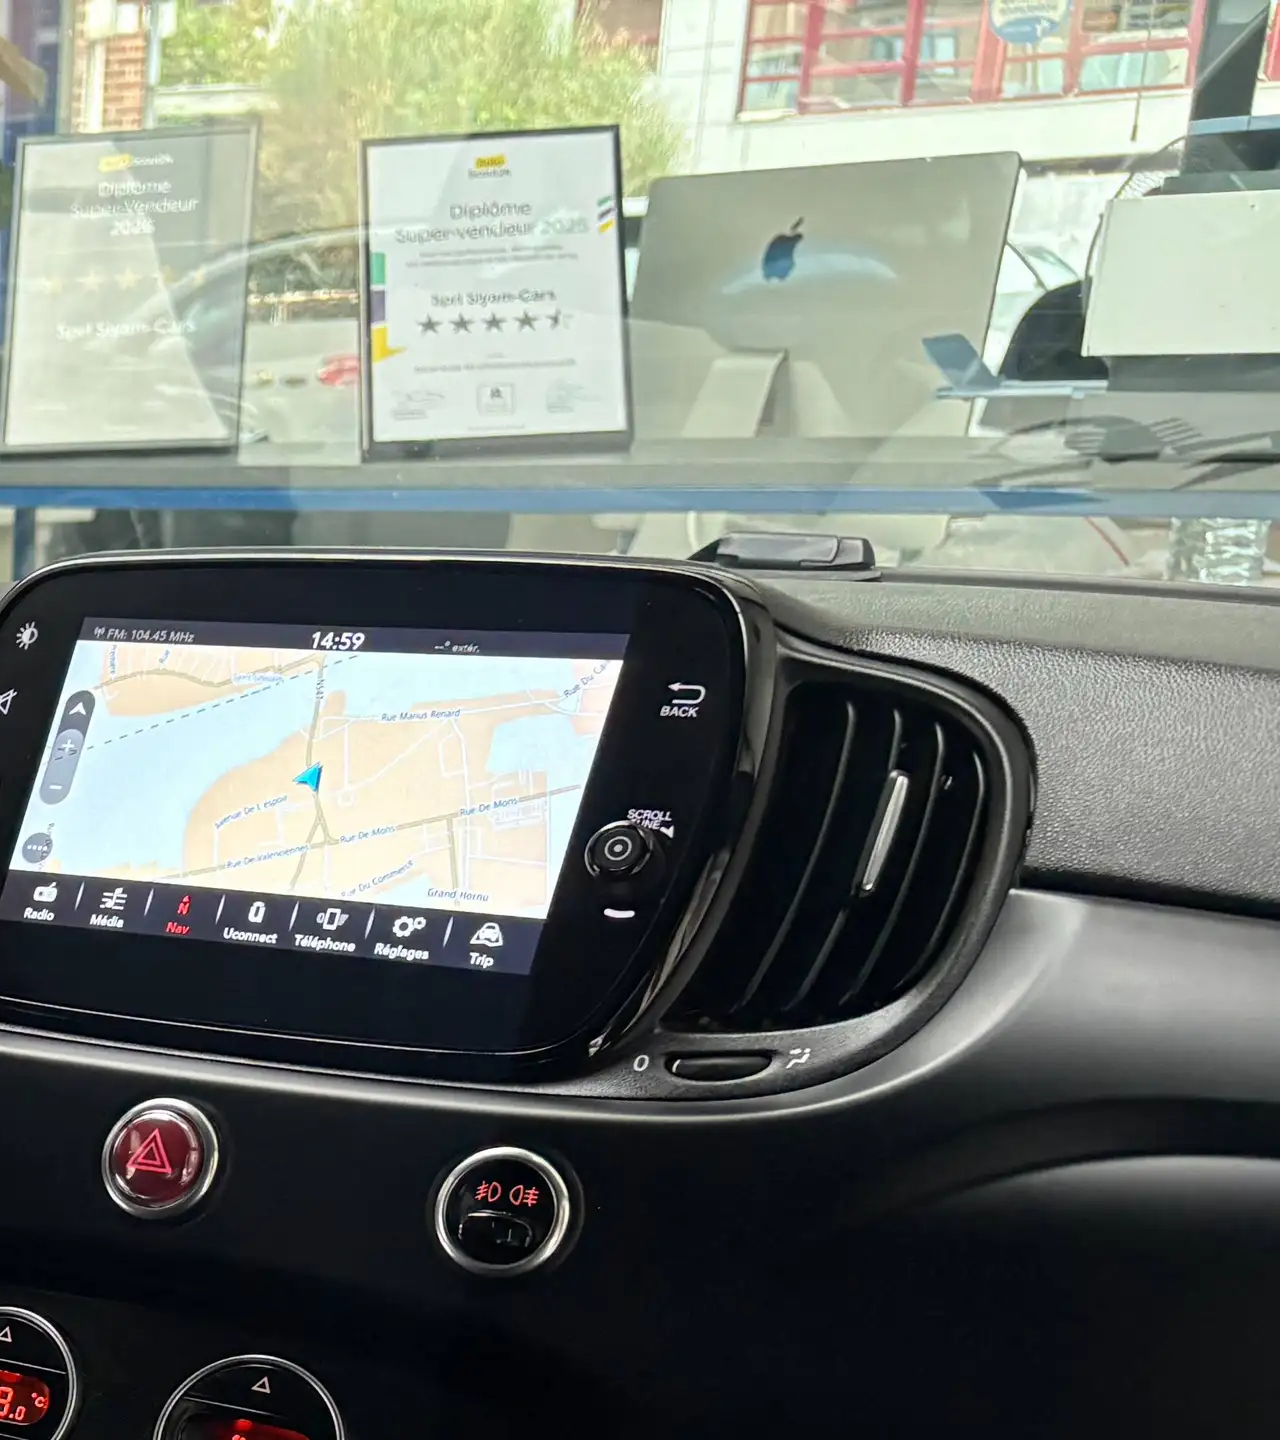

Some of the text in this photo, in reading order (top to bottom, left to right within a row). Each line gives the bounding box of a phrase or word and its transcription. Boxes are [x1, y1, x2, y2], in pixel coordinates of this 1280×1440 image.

[449, 200, 533, 222] Diplôme
[107, 628, 195, 643] FM: 104.45 MHz
[311, 631, 365, 650] 14:59
[381, 712, 397, 722] Rue
[430, 708, 461, 720] Renard
[659, 705, 700, 718] BACK
[460, 797, 518, 817] Rue De Mons
[627, 808, 672, 822] SCROLL
[340, 833, 357, 844] Rue
[358, 829, 370, 840] De
[371, 825, 396, 838] Mons
[427, 888, 457, 899] Grand
[23, 907, 55, 922] Radio
[90, 913, 125, 929] Média
[166, 921, 190, 935] Nav
[223, 927, 278, 944] Uconnect
[294, 934, 356, 952] Téléphone
[374, 942, 429, 961] Réglages
[469, 952, 494, 968] Trip
